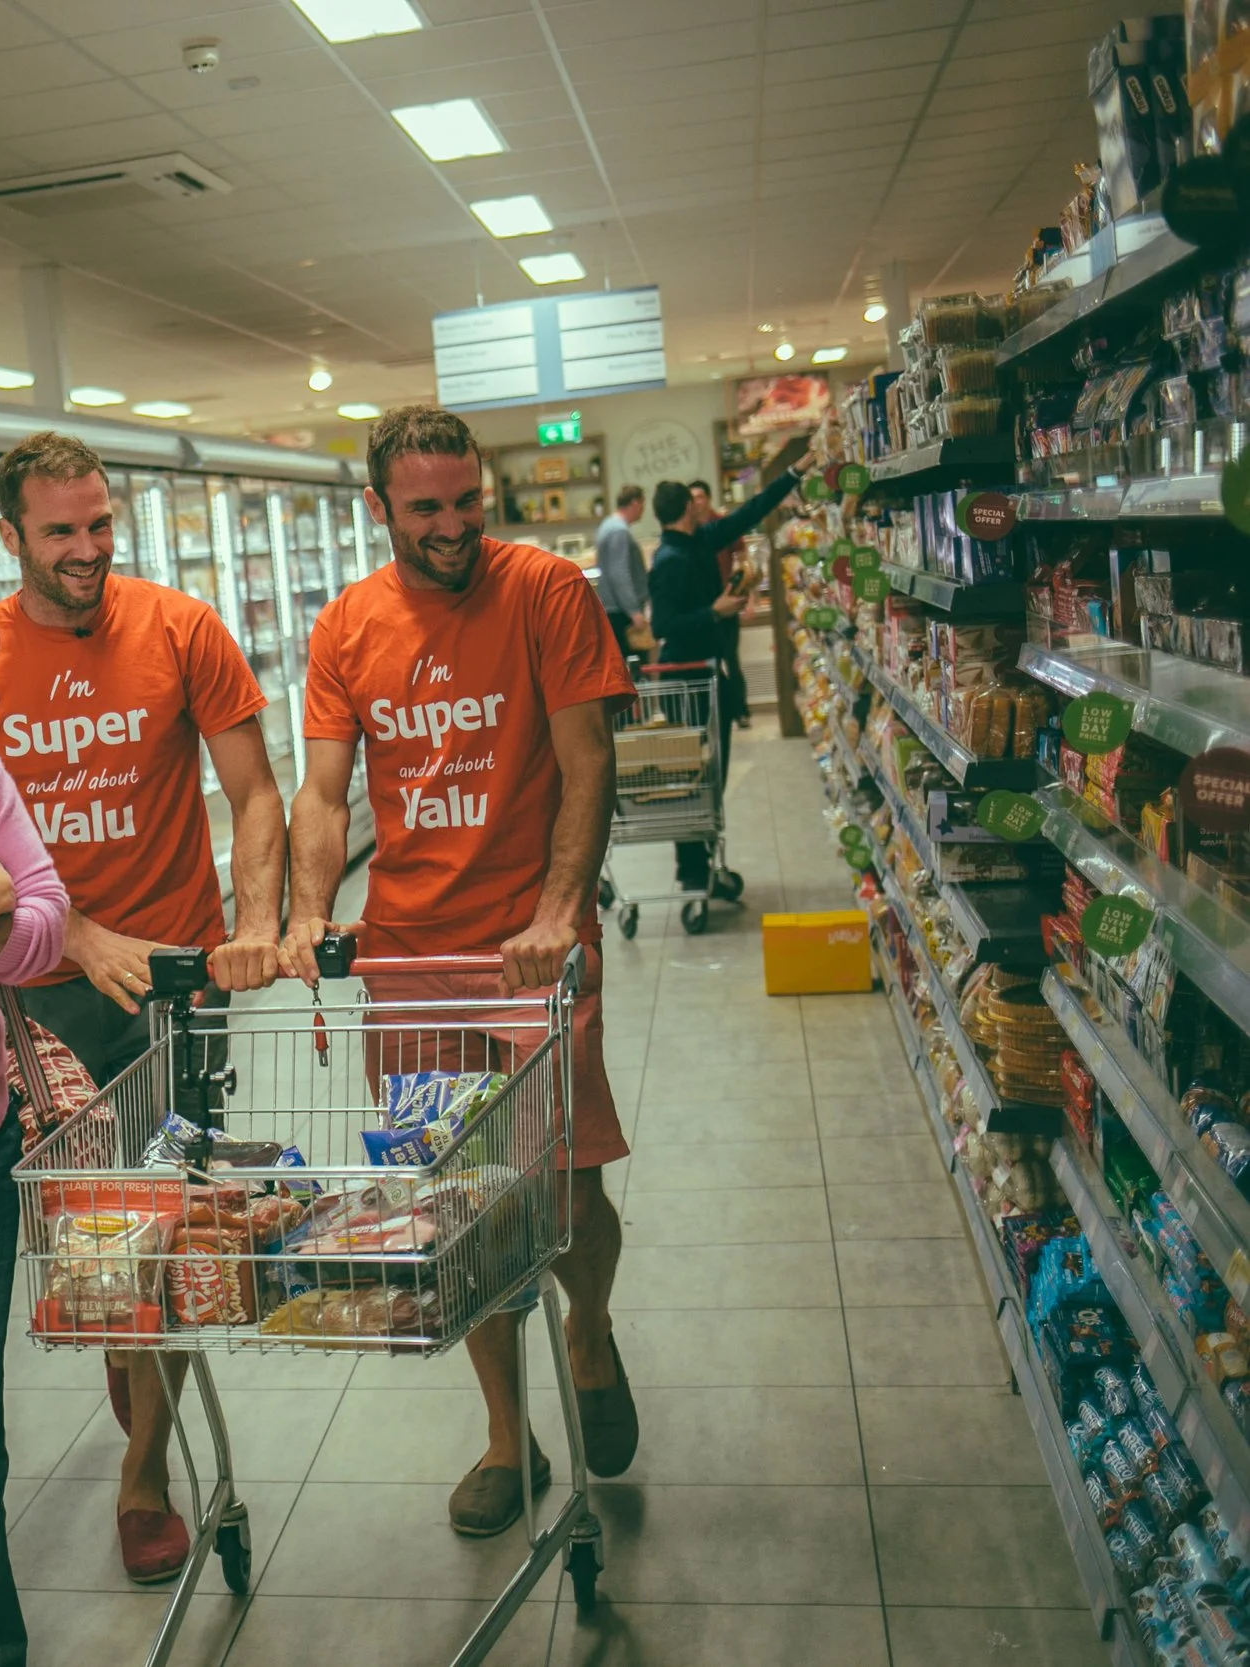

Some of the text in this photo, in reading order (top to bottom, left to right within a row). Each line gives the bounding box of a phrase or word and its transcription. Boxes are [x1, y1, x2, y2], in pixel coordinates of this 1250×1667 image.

[973, 508, 1006, 518] SPECIAL
[975, 516, 1001, 525] OFFER
[412, 655, 452, 685] I'm
[50, 670, 95, 701] I'm
[1082, 707, 1112, 717] LOW
[1082, 715, 1111, 724] EVERY
[370, 693, 505, 749] Super
[1081, 722, 1109, 735] DAY
[2, 708, 148, 764] Super
[1079, 733, 1107, 742] PRICES
[400, 756, 429, 778] and
[444, 751, 495, 777] about
[26, 766, 139, 796] and all about
[1193, 774, 1250, 795] SPECIAL
[1196, 788, 1246, 808] OFFER
[399, 785, 488, 830] Valu
[1014, 803, 1034, 817] LOW
[33, 800, 136, 844] Valu
[1006, 813, 1026, 828] DAY
[1102, 915, 1130, 928] EVERY
[1104, 907, 1134, 922] LOW
[1100, 922, 1127, 937] DAY
[1096, 932, 1124, 945] PRICES
[101, 1181, 124, 1193] FOR
[1118, 1428, 1149, 1460] OREO
[1103, 1449, 1136, 1481] OREO
[1124, 1514, 1151, 1545] OREO
